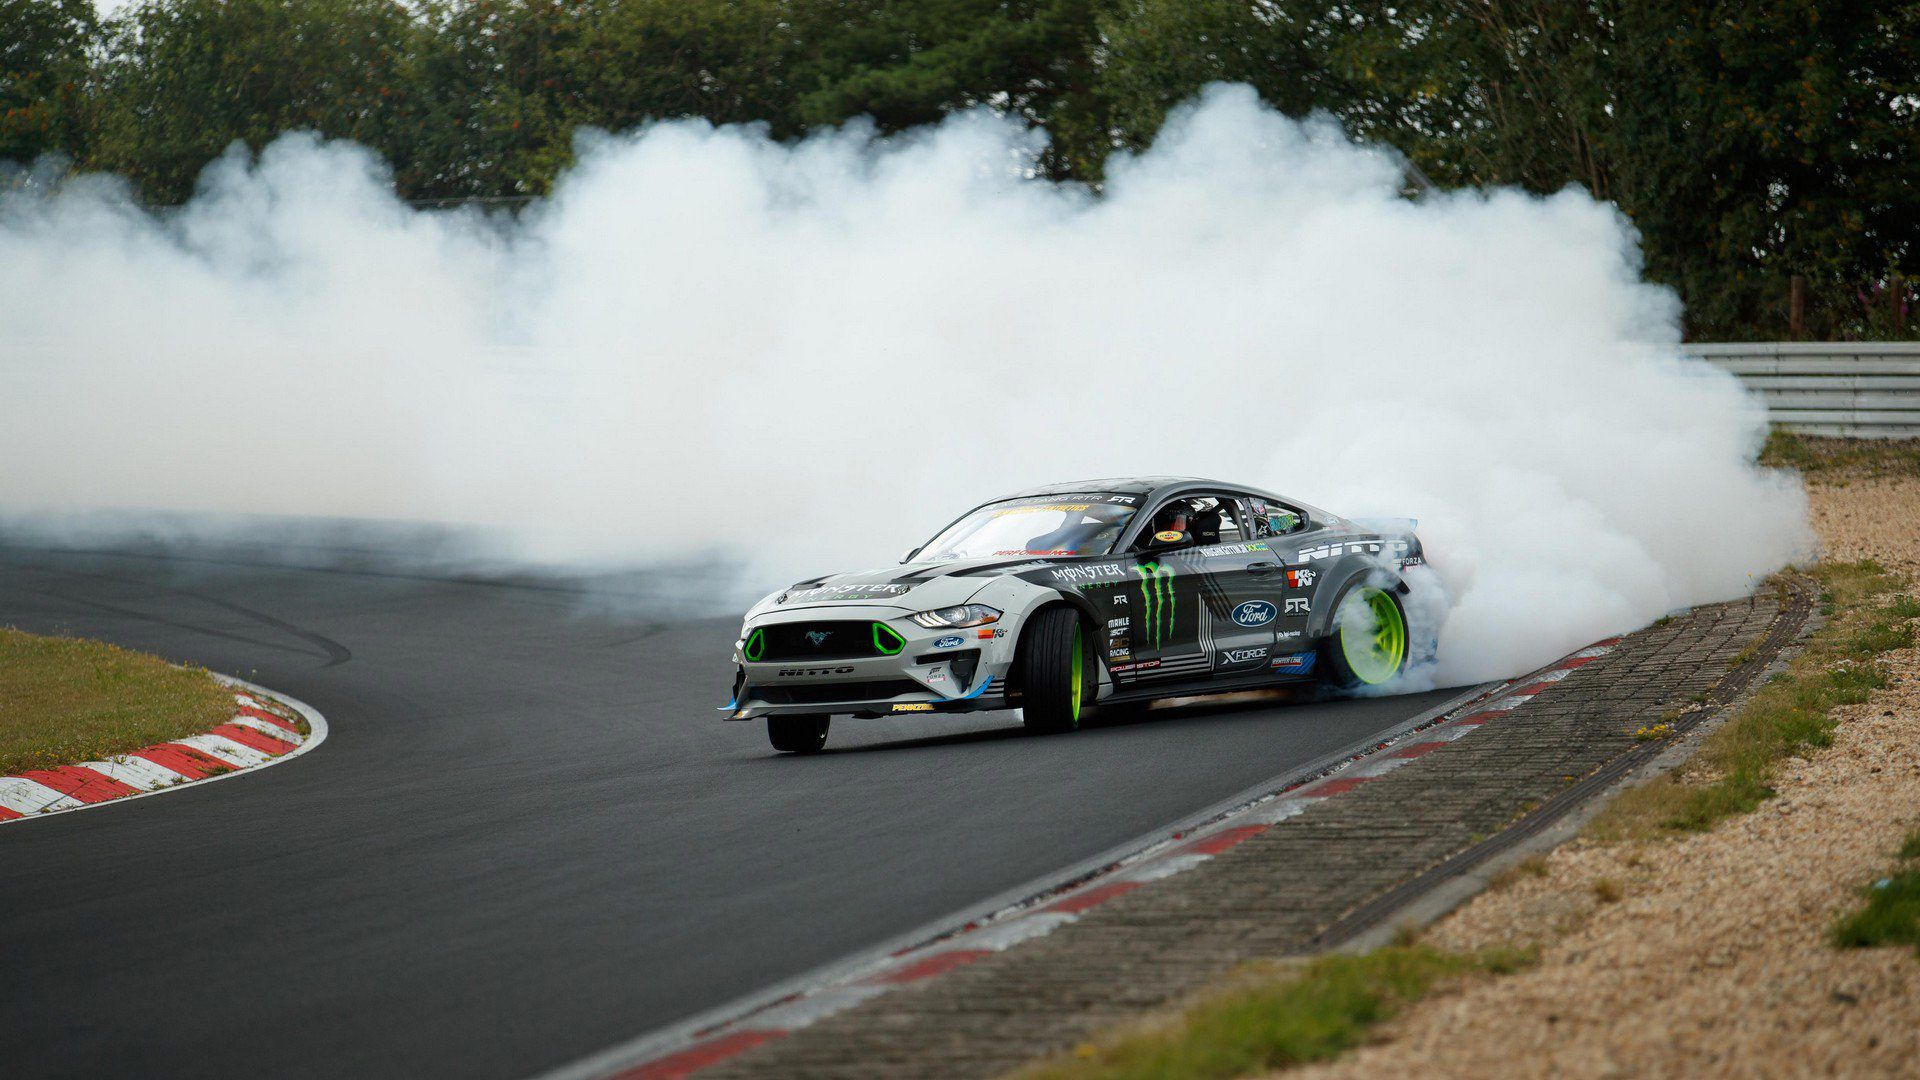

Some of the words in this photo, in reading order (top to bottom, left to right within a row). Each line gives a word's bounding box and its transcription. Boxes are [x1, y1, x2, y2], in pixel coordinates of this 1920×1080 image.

[1402, 557, 1423, 566] FORZA
[1071, 581, 1119, 591] ENERGY
[1240, 604, 1268, 622] Ford
[1107, 616, 1130, 628] MAHLE
[938, 638, 960, 647] Ford
[1109, 648, 1130, 657] RACING
[1220, 647, 1268, 666] XFORCE
[778, 666, 855, 676] NITTO
[1110, 664, 1136, 672] POWER
[1136, 660, 1160, 669] STOP
